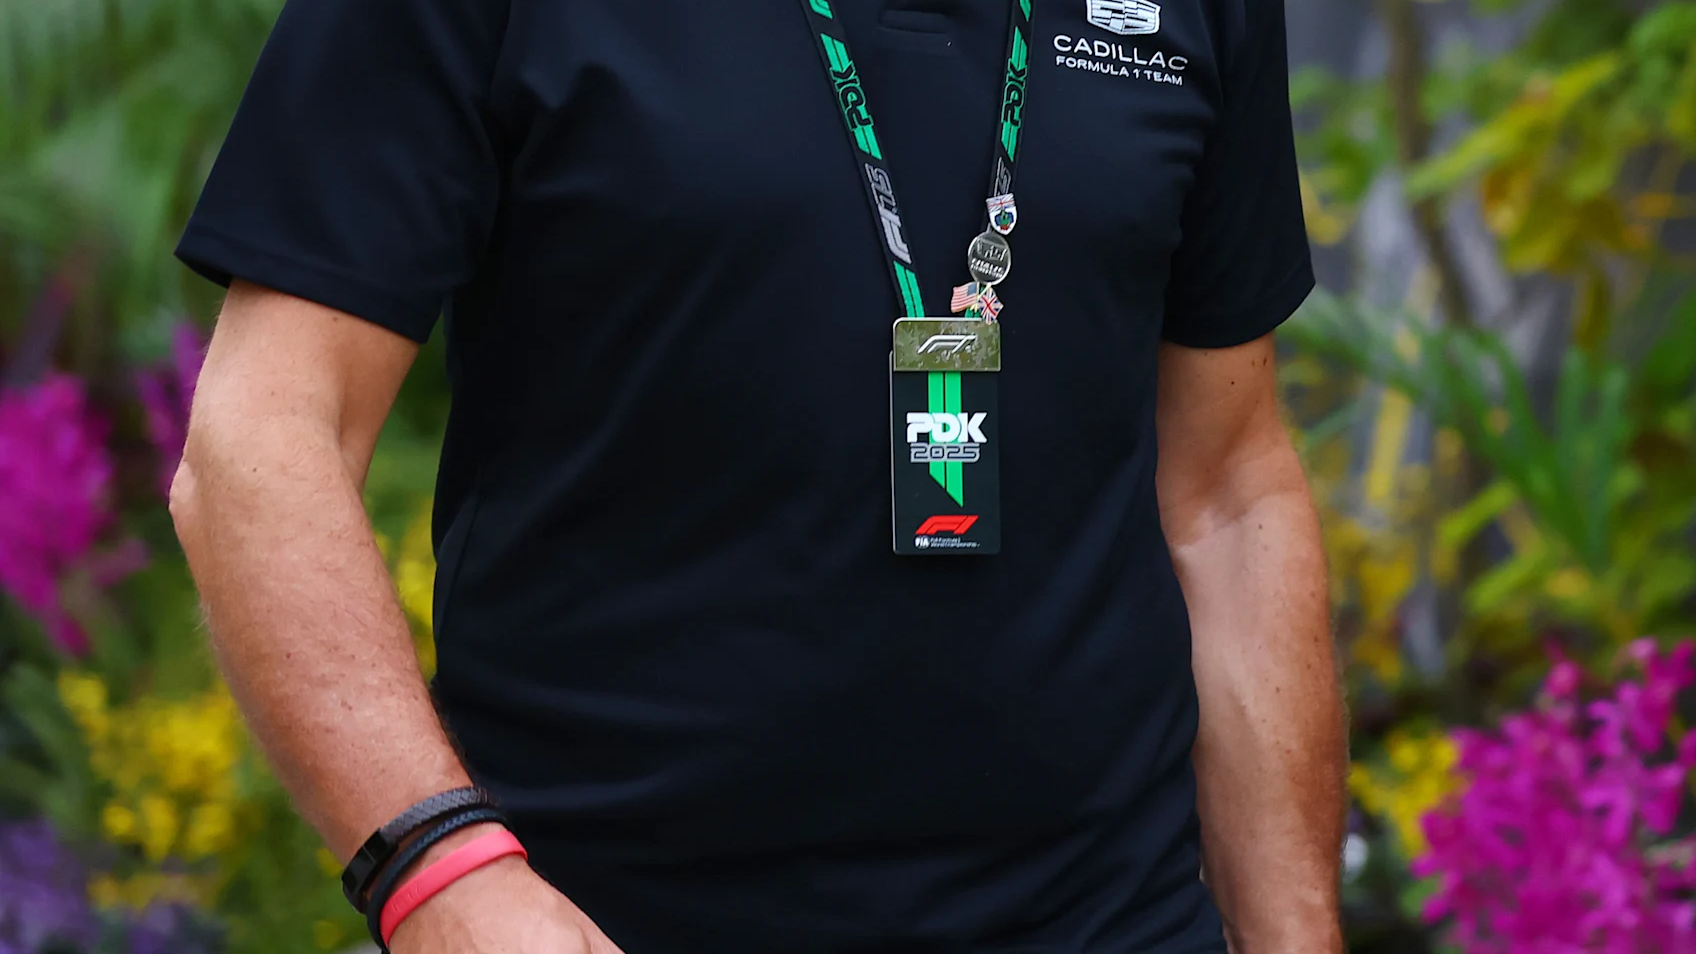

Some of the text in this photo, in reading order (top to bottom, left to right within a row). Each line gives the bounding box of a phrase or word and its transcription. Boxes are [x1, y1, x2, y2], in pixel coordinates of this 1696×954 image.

[1053, 34, 1188, 70] CADILLAC
[1055, 54, 1183, 86] FORMULA 1 TEAM
[906, 412, 988, 443] PDK
[909, 442, 981, 463] 2025
[914, 514, 979, 535] F1
